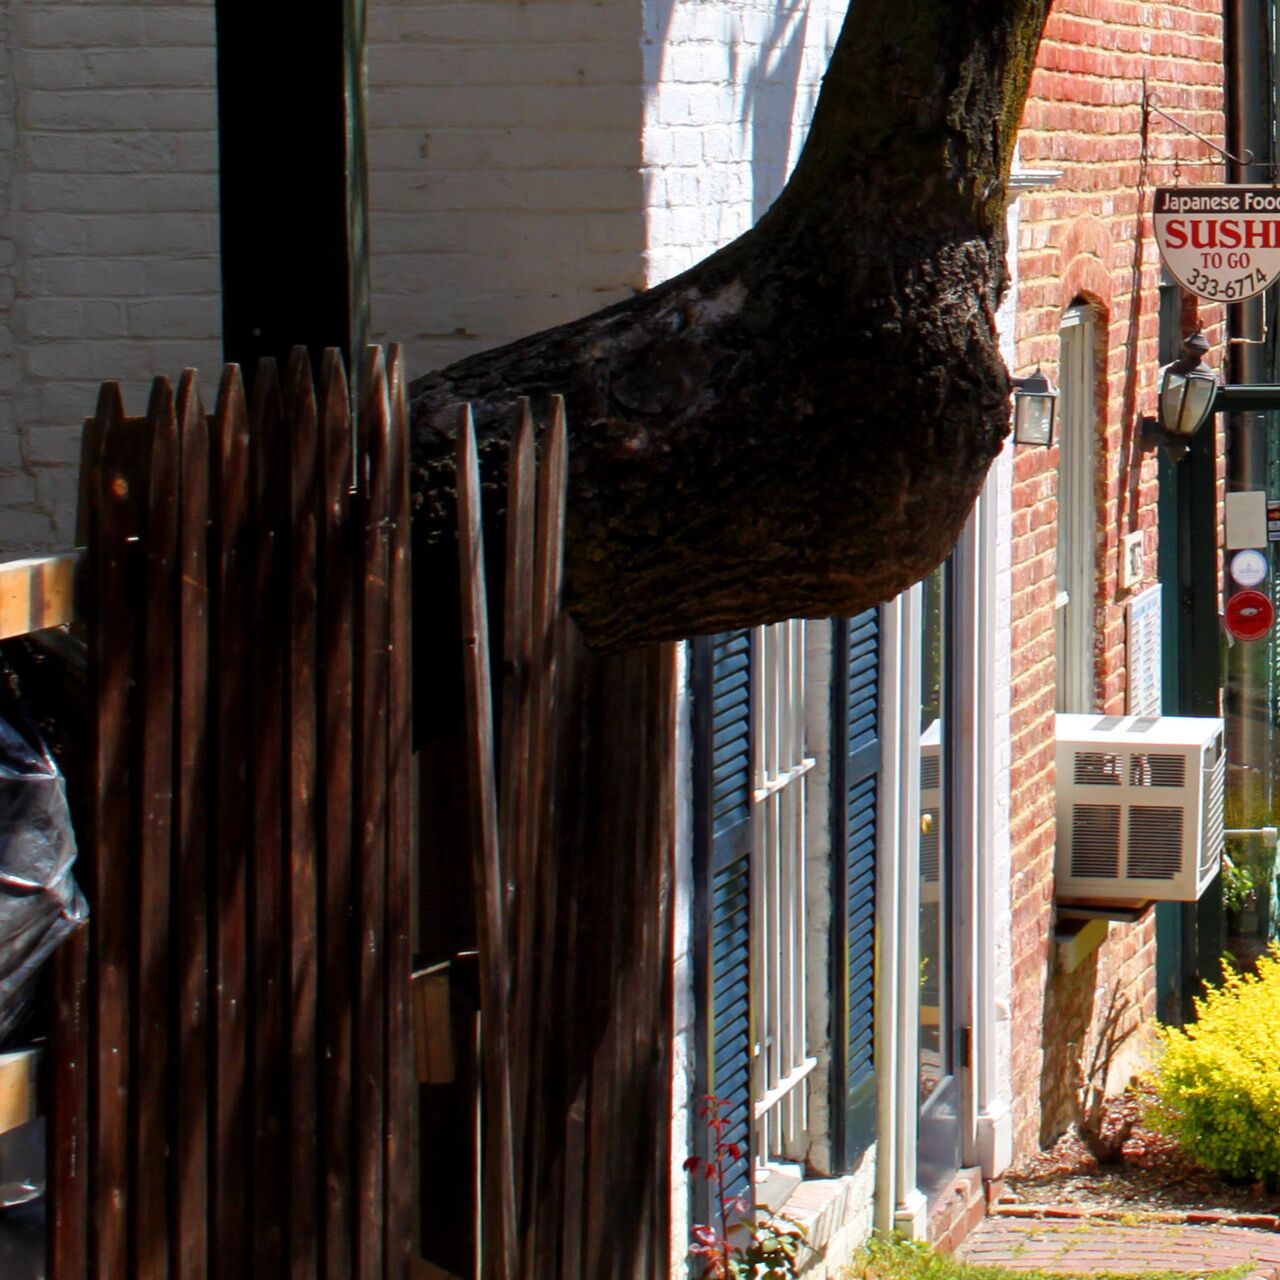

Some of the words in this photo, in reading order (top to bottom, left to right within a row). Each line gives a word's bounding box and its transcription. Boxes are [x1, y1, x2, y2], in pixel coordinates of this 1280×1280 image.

[1162, 192, 1240, 213] Japanese
[1200, 252, 1223, 269] TO
[1227, 252, 1251, 269] GO
[1186, 267, 1267, 298] 333-6774
